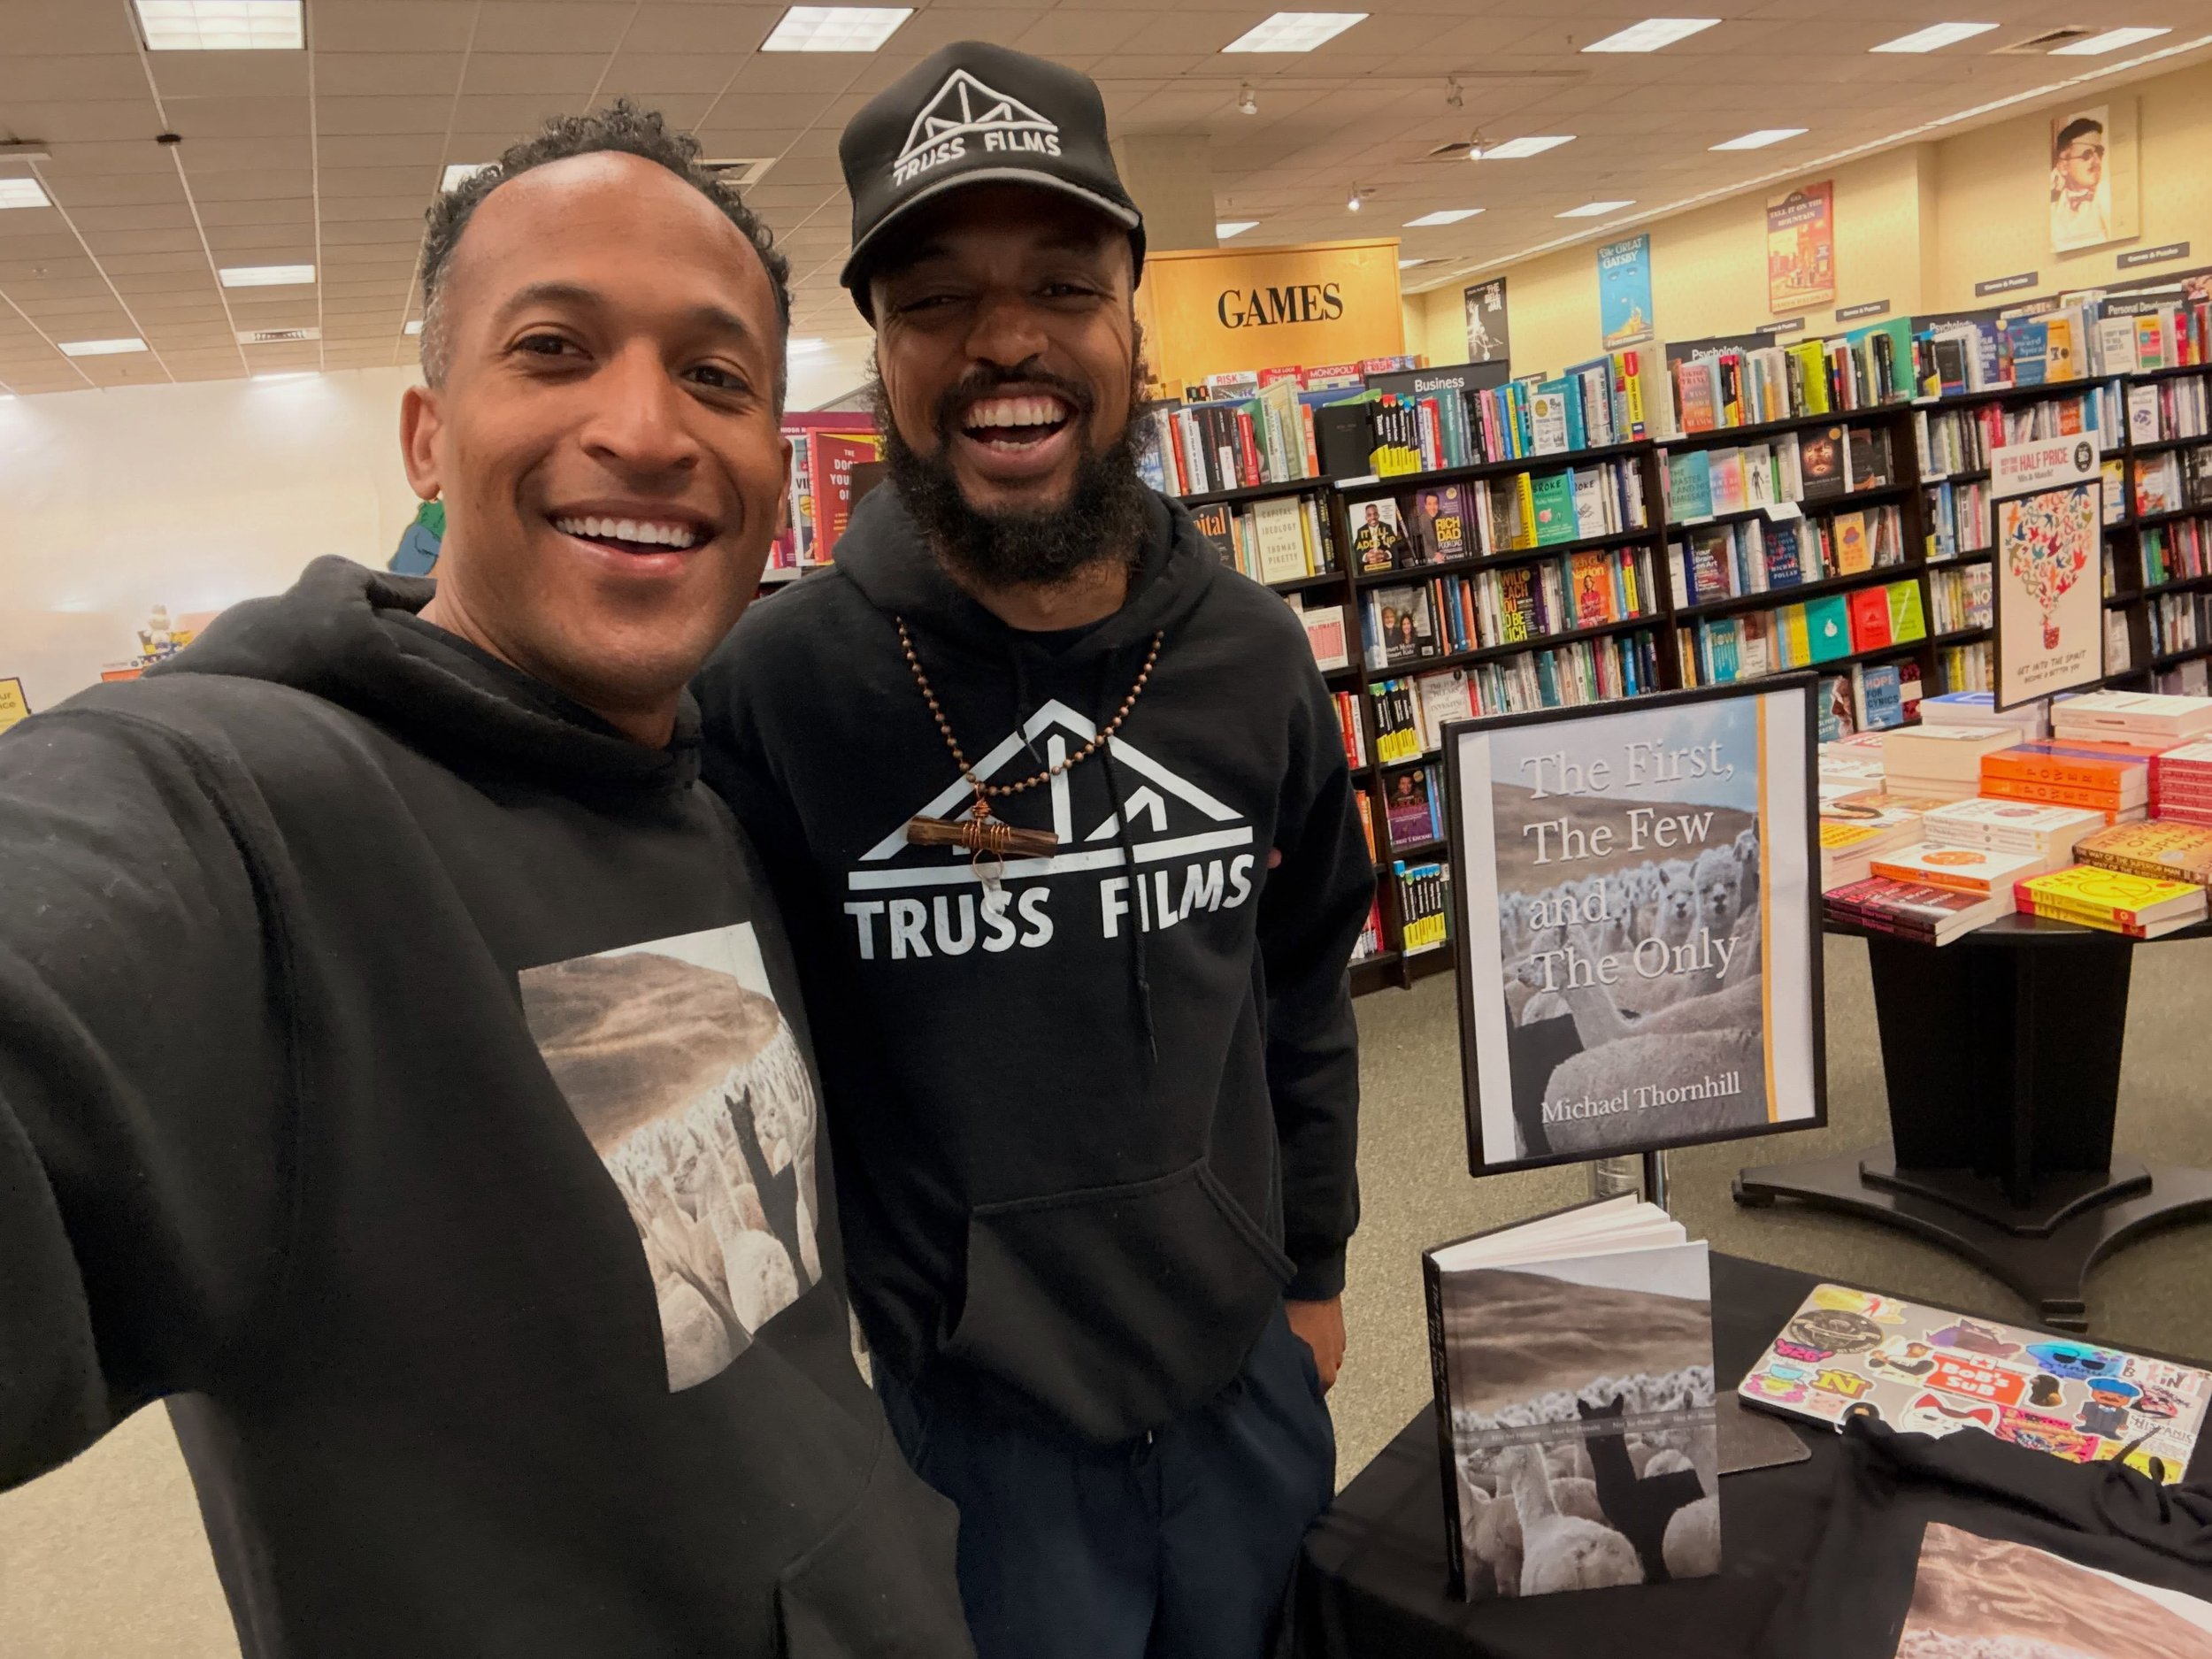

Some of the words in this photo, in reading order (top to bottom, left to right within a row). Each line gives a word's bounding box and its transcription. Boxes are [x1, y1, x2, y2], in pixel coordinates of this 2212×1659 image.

[893, 136, 965, 186] TRUSS
[984, 129, 1062, 157] FILMS
[1616, 238, 1642, 254] GREAT
[1603, 250, 1639, 269] GATSBY
[1218, 282, 1343, 329] GAMES
[2108, 303, 2139, 315] Personal
[1692, 346, 1747, 361] Psychology
[1217, 374, 1238, 385] RISK
[1310, 365, 1354, 379] MONOPOLY
[1415, 376, 1464, 392] Business
[2020, 452, 2040, 471] HALF
[2043, 447, 2069, 467] PRICE
[830, 474, 849, 485] YOU
[1532, 480, 1562, 494] BROKE
[1575, 480, 1594, 492] OKE
[1261, 509, 1293, 518] CAPITAL
[1194, 507, 1226, 536] ital
[1262, 523, 1296, 535] IDEOLOGY
[1436, 516, 1460, 531] RICH
[1437, 528, 1461, 542] DAD
[1267, 542, 1296, 554] THOMAS
[1356, 540, 1380, 550] ADDS
[1383, 536, 1396, 548] UP
[1269, 554, 1298, 565] PIKETTY
[1502, 571, 1523, 586] WILL
[1774, 570, 1798, 579] POLLAN
[1504, 582, 1528, 598] EACH
[1973, 589, 1992, 605] NO
[1504, 599, 1517, 613] OU
[1513, 611, 1525, 626] BE
[1973, 610, 1991, 626] YO
[1509, 625, 1527, 641] ICH
[2051, 657, 2062, 665] THE
[1865, 674, 1894, 688] HOPE
[1867, 687, 1883, 698] FOR
[1867, 695, 1899, 708] CYNICS
[1521, 750, 1610, 799] The
[1624, 738, 1734, 787] First,
[2026, 768, 2093, 784] POWER
[2024, 786, 2088, 802] POWER
[1524, 818, 1613, 865] The
[1626, 808, 1714, 853] Few
[2088, 850, 2104, 859] WAY
[2116, 856, 2129, 864] THE
[2130, 859, 2162, 872] SUPERIOR
[2163, 866, 2181, 875] MAN
[2092, 860, 2108, 869] WAY
[844, 887, 1054, 960] TRUSS
[1100, 854, 1256, 938] FILMS
[1529, 879, 1611, 929] and
[1530, 946, 1619, 994] The
[1633, 927, 1740, 979] Only
[1541, 1091, 1629, 1124] Michael
[1634, 1071, 1741, 1110] Thornhill
[1817, 1372, 1865, 1394] N
